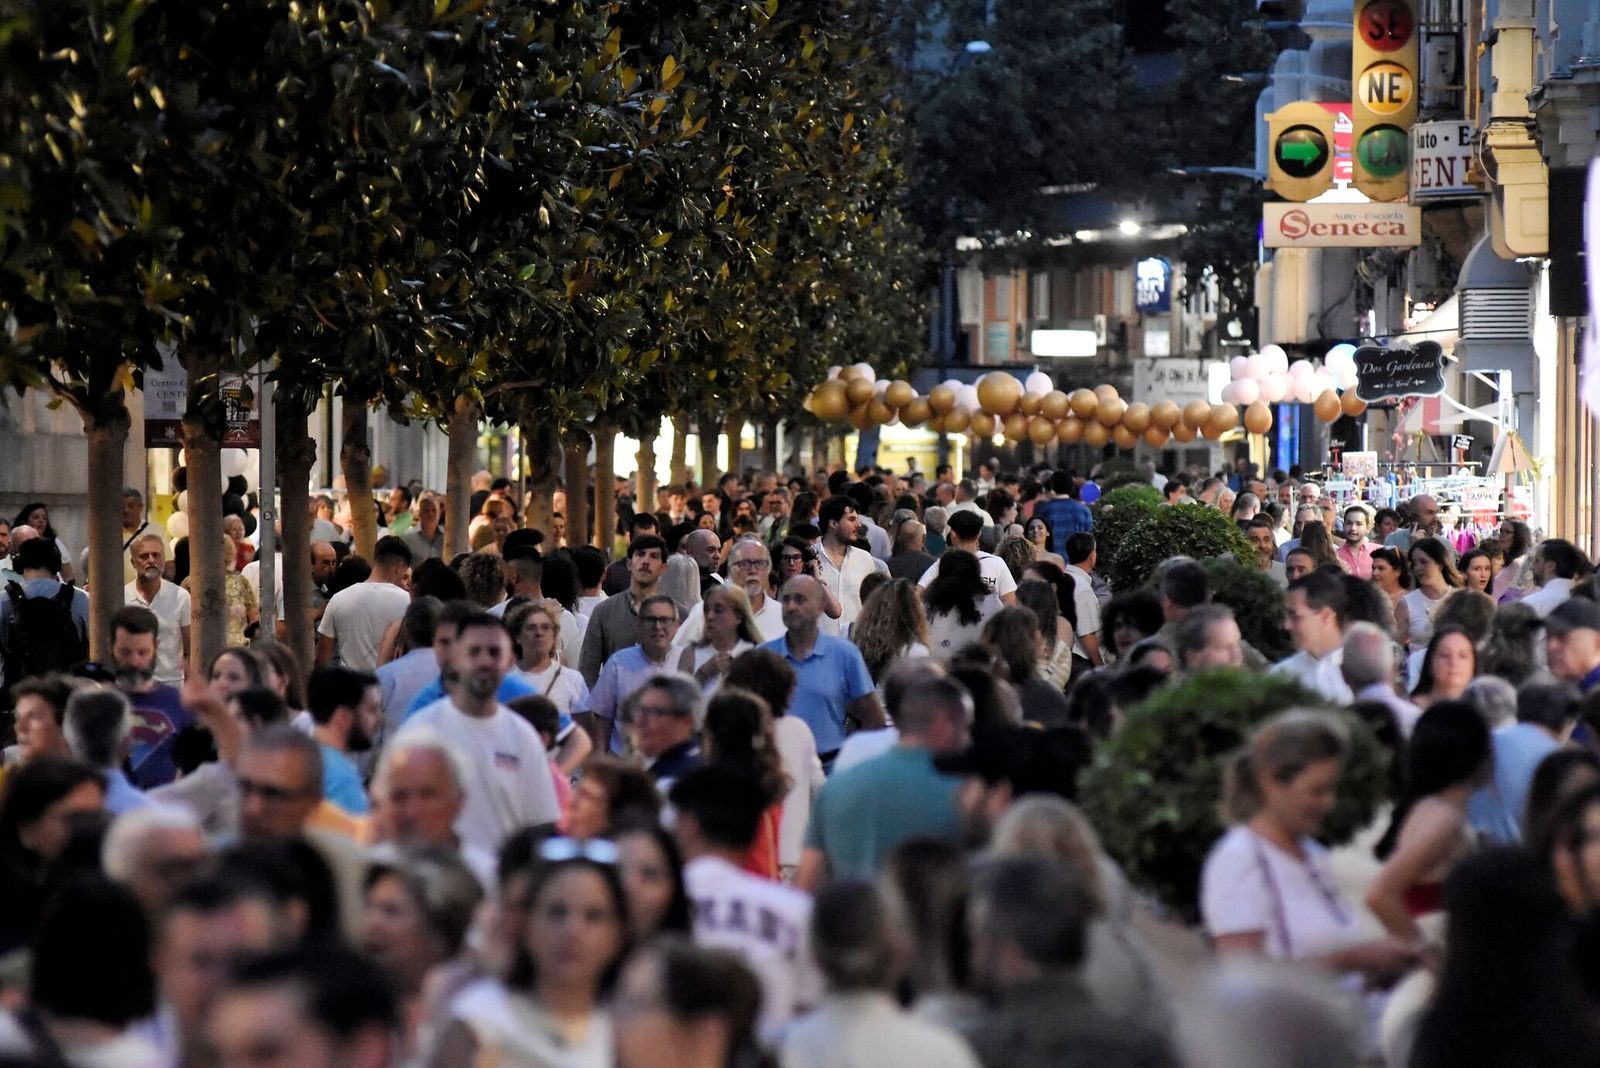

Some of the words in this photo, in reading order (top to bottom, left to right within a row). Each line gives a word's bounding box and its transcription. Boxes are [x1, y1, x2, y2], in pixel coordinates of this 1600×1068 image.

[1368, 8, 1402, 40] SE
[1367, 72, 1403, 104] NE
[1279, 208, 1408, 240] Seneca
